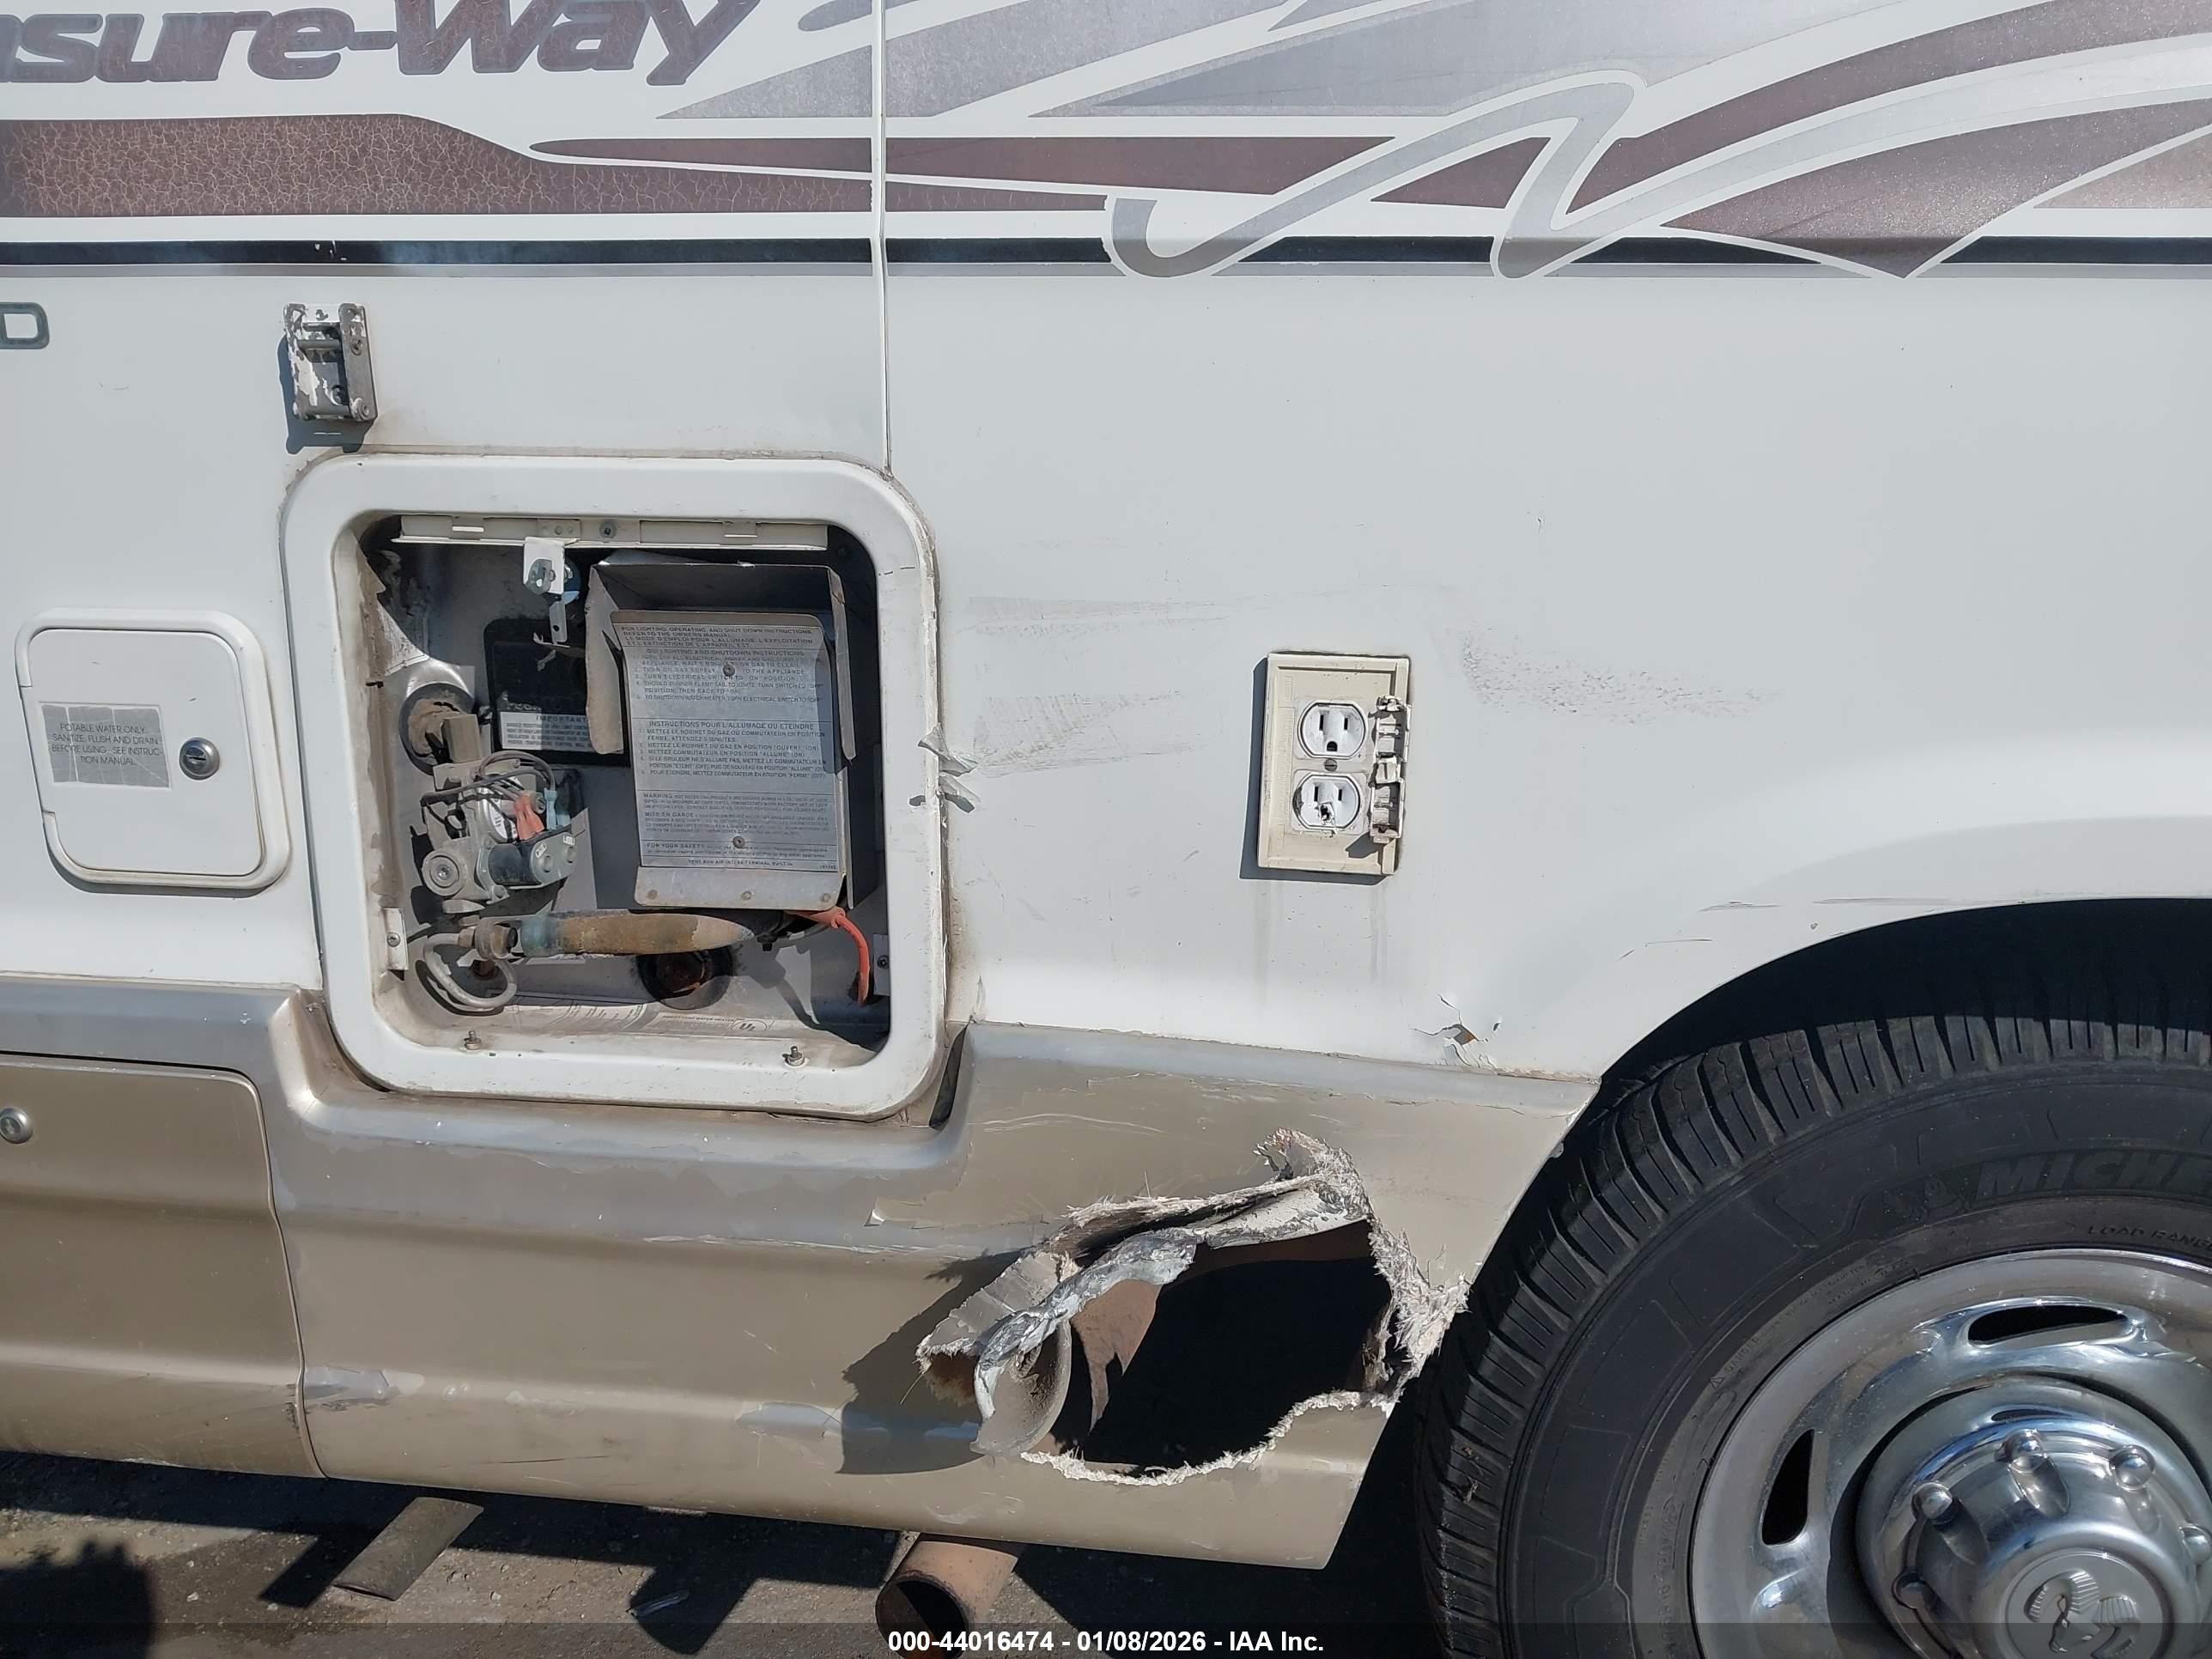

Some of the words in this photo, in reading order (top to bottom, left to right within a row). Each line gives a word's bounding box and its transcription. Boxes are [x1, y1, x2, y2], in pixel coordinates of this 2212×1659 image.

[0, 0, 761, 85] sure-Way
[60, 723, 94, 732] POTABLE
[95, 724, 121, 732] WATER
[88, 735, 111, 744] FLUSH
[112, 735, 131, 744] AND
[133, 736, 159, 744] DRAIN
[52, 744, 81, 753] BEFORE
[82, 745, 107, 754] USING
[112, 746, 126, 755] SEE
[80, 756, 99, 764] TION
[2087, 1225, 2145, 1237] LOAD
